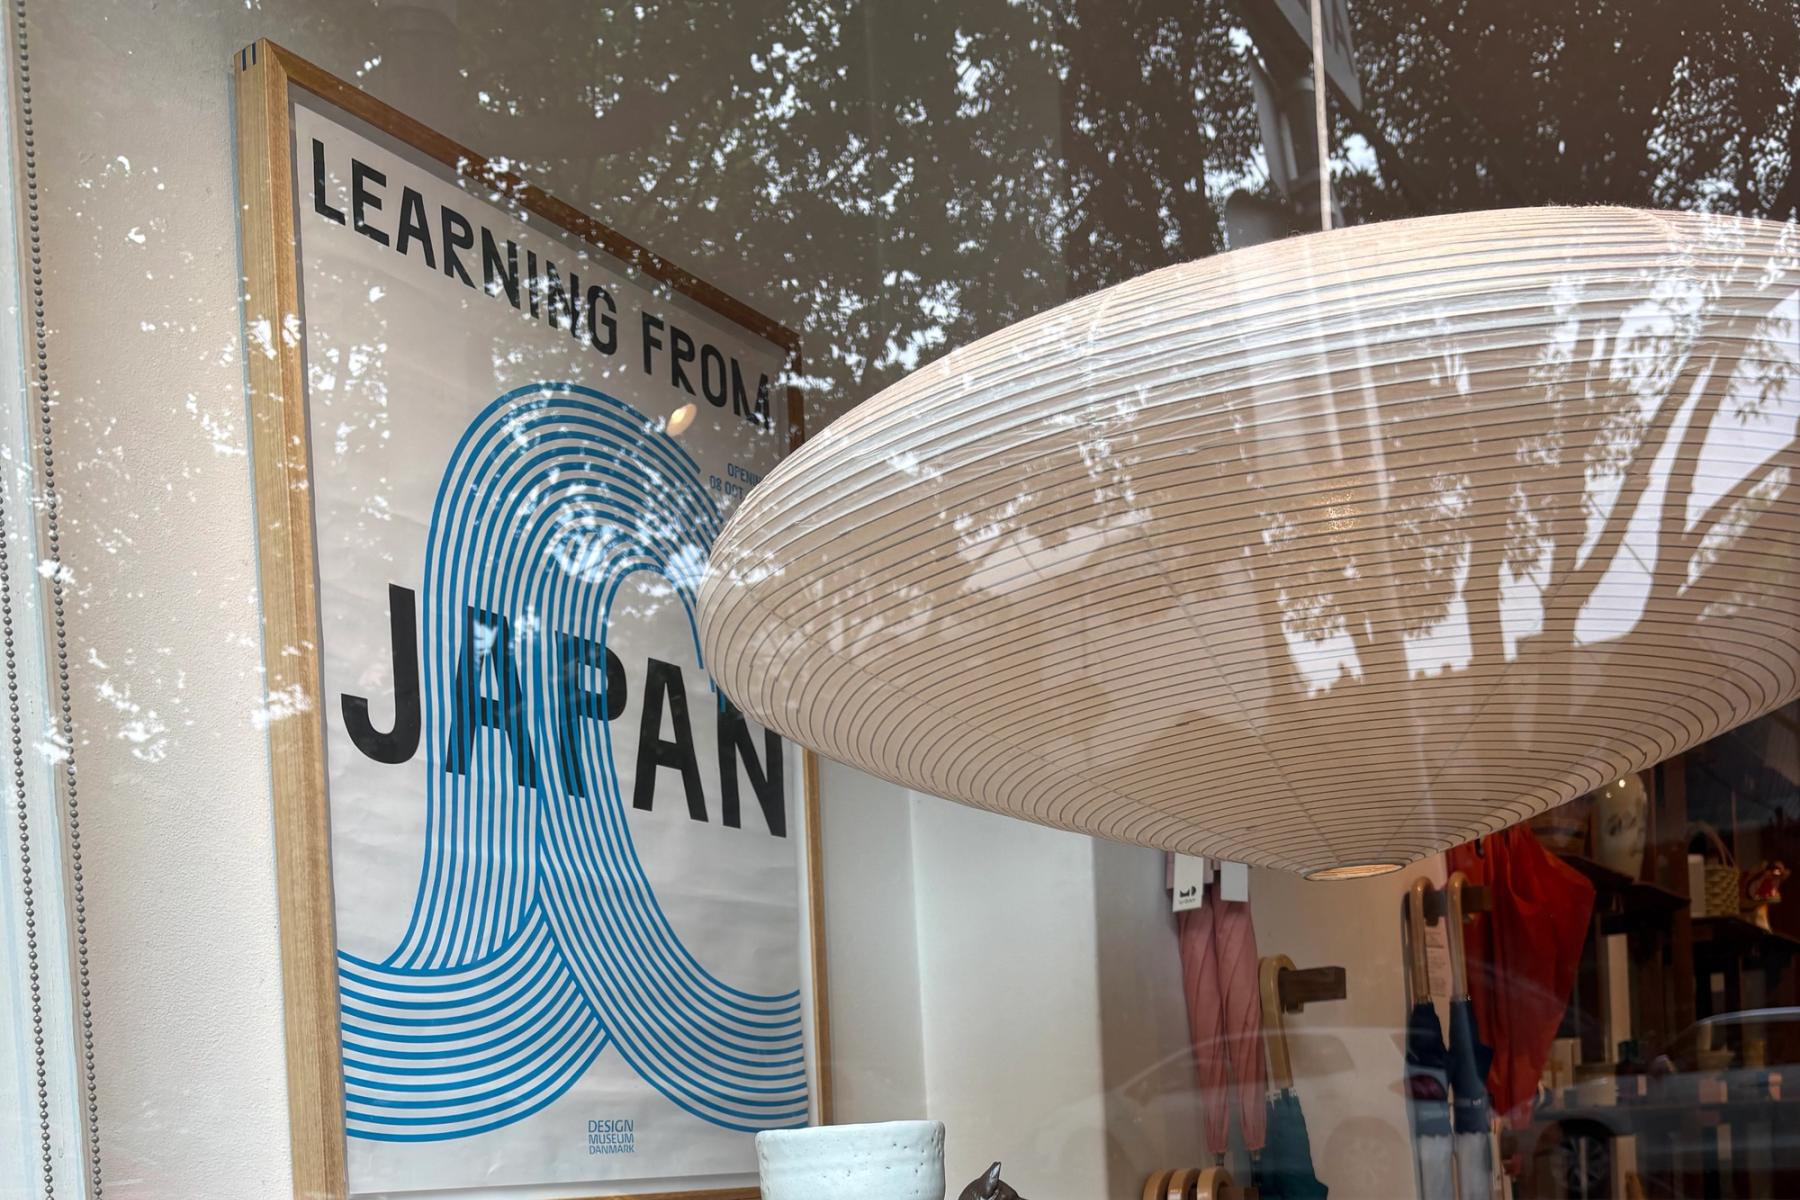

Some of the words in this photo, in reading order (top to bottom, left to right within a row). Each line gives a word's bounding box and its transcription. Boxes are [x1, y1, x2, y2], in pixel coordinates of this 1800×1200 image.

[312, 138, 618, 356] LEARNING
[642, 311, 769, 431] FROM
[341, 583, 787, 838] JAPAN
[588, 1119, 634, 1133] DESIGN
[588, 1133, 634, 1144] MUSEUM
[589, 1144, 635, 1155] DANMARK
